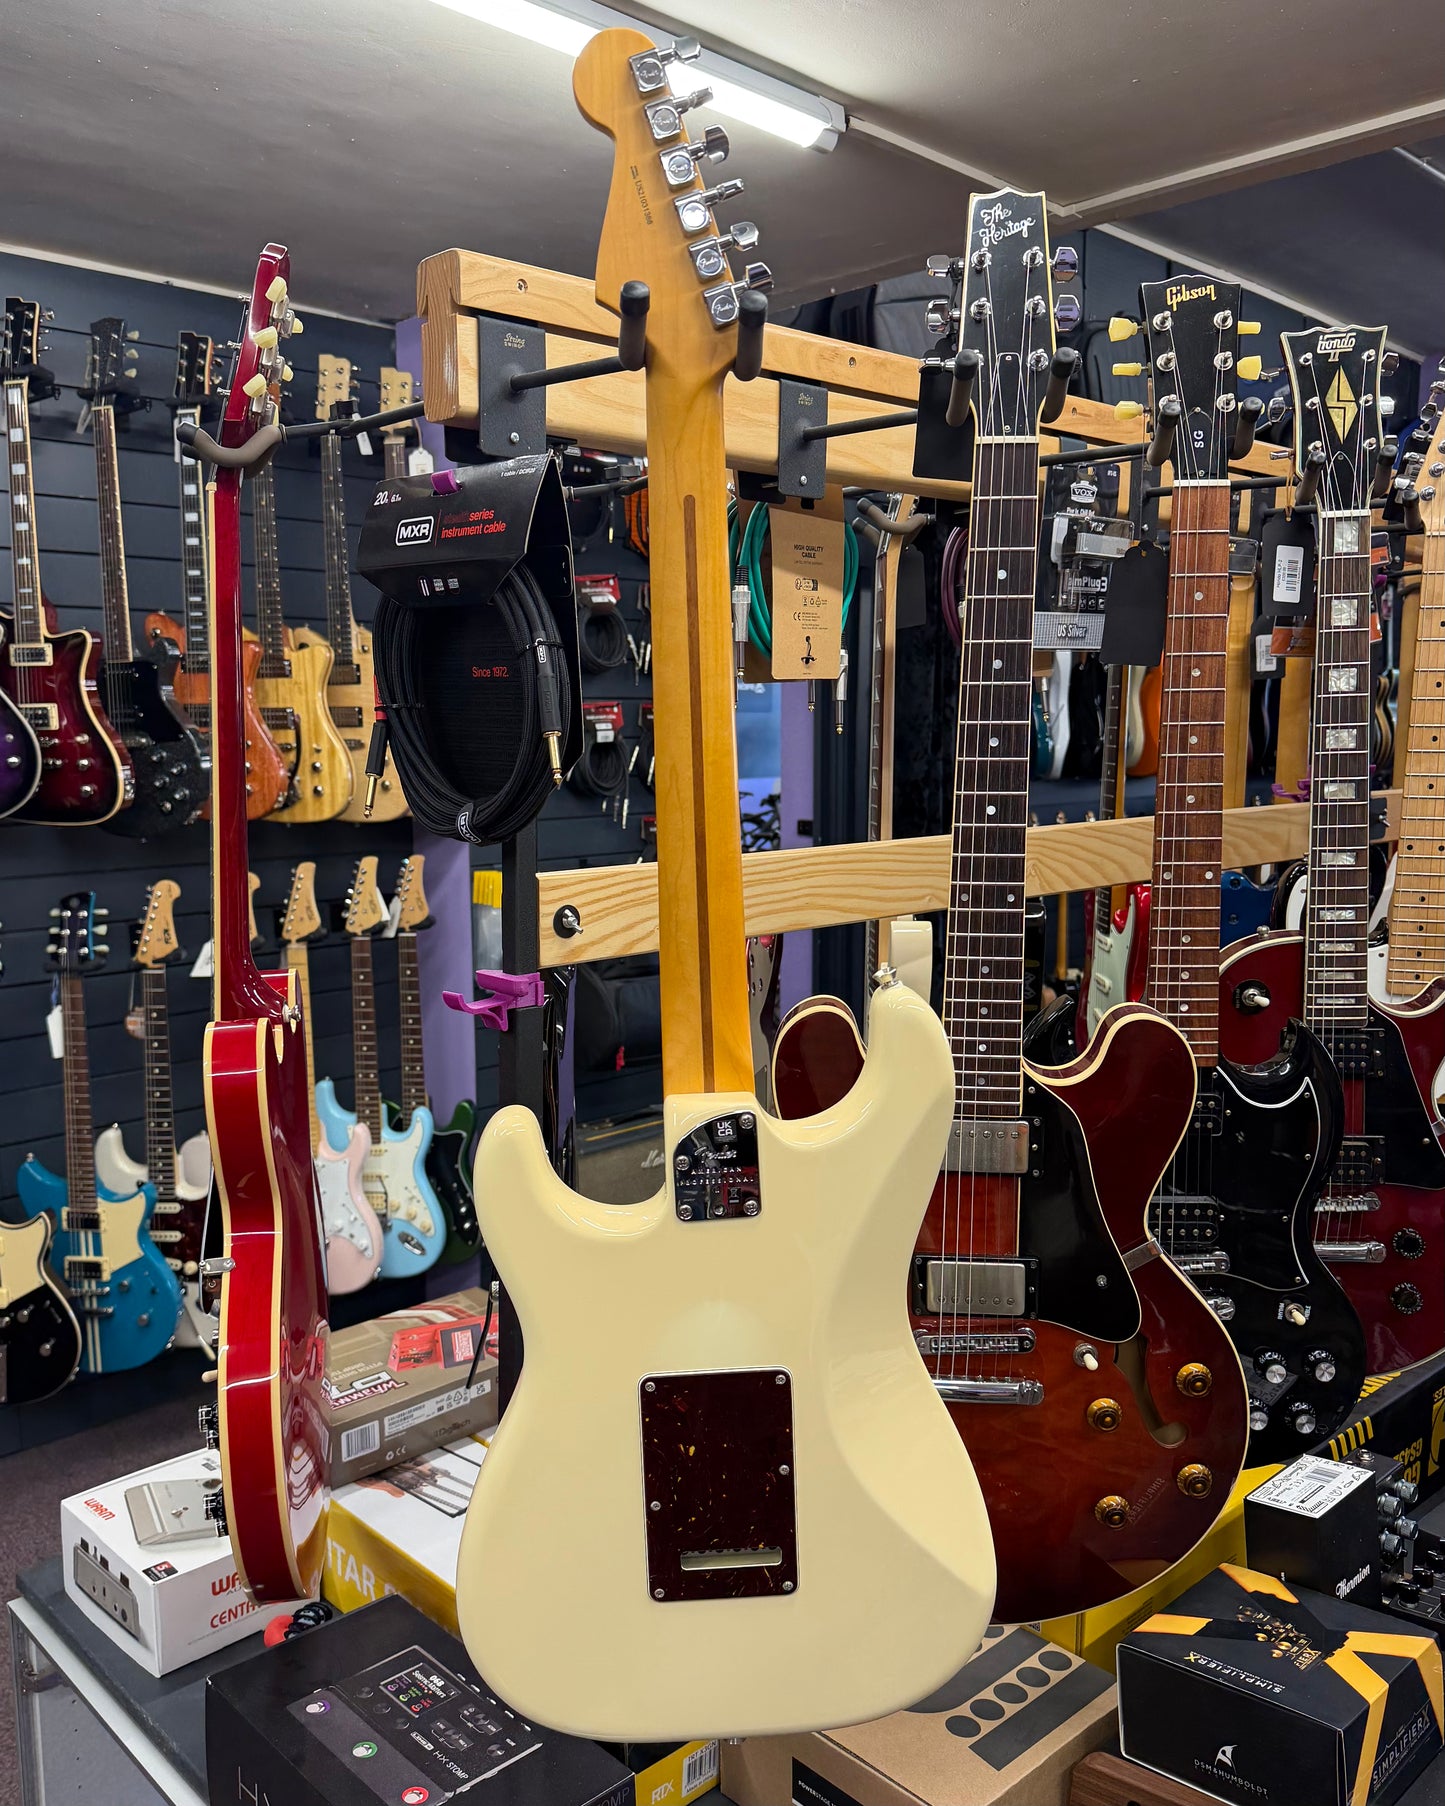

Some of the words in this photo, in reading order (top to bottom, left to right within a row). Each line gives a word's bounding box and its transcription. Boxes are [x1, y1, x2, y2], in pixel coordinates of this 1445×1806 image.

[980, 203, 1012, 226] The
[979, 217, 1036, 247] Heritage
[1166, 284, 1217, 312] Gibson
[1194, 430, 1204, 449] SG
[1074, 488, 1093, 498] VOX
[469, 509, 495, 522] series
[399, 523, 430, 540] MXR
[441, 525, 482, 539] instrument
[483, 521, 507, 534] cable
[1057, 623, 1067, 638] US
[1067, 623, 1087, 639] Silver
[472, 666, 491, 678] Since
[492, 666, 509, 678] 1972.
[460, 815, 477, 842] MXR
[717, 1121, 732, 1129] UK
[717, 1129, 733, 1137] CA
[84, 1498, 116, 1521] WARM
[326, 1537, 376, 1600] ITAR
[211, 1571, 241, 1596] WA
[1335, 1564, 1371, 1599] Thermion
[433, 1750, 448, 1764] HX
[446, 1761, 469, 1780] STOMP
[651, 1779, 675, 1805] RTX
